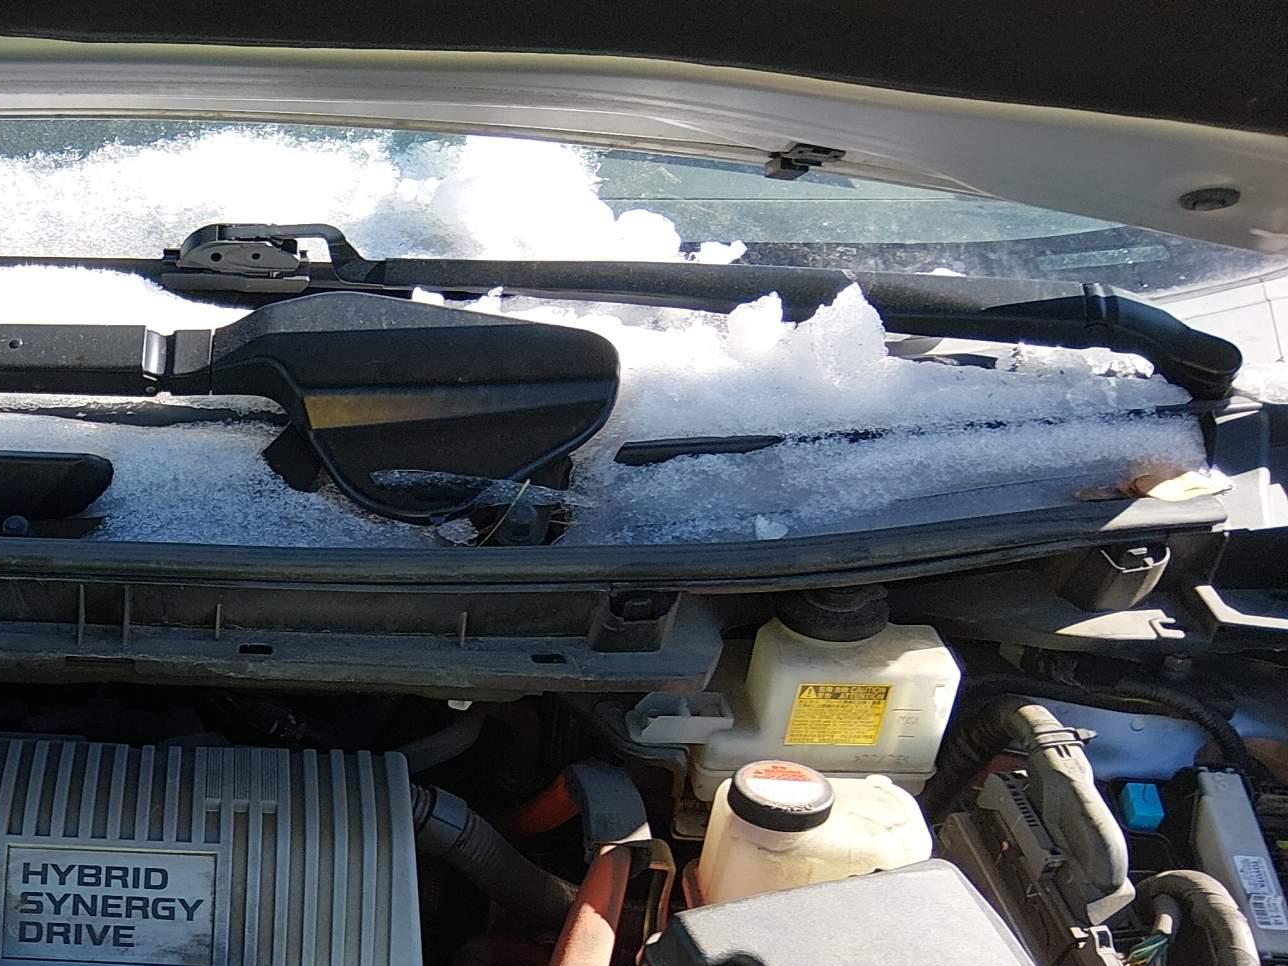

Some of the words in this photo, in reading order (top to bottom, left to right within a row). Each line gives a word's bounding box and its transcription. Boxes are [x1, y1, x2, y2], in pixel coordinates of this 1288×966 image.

[21, 862, 169, 890] HYBRID
[19, 891, 204, 922] SYNERGY
[18, 921, 136, 948] DRIVE
